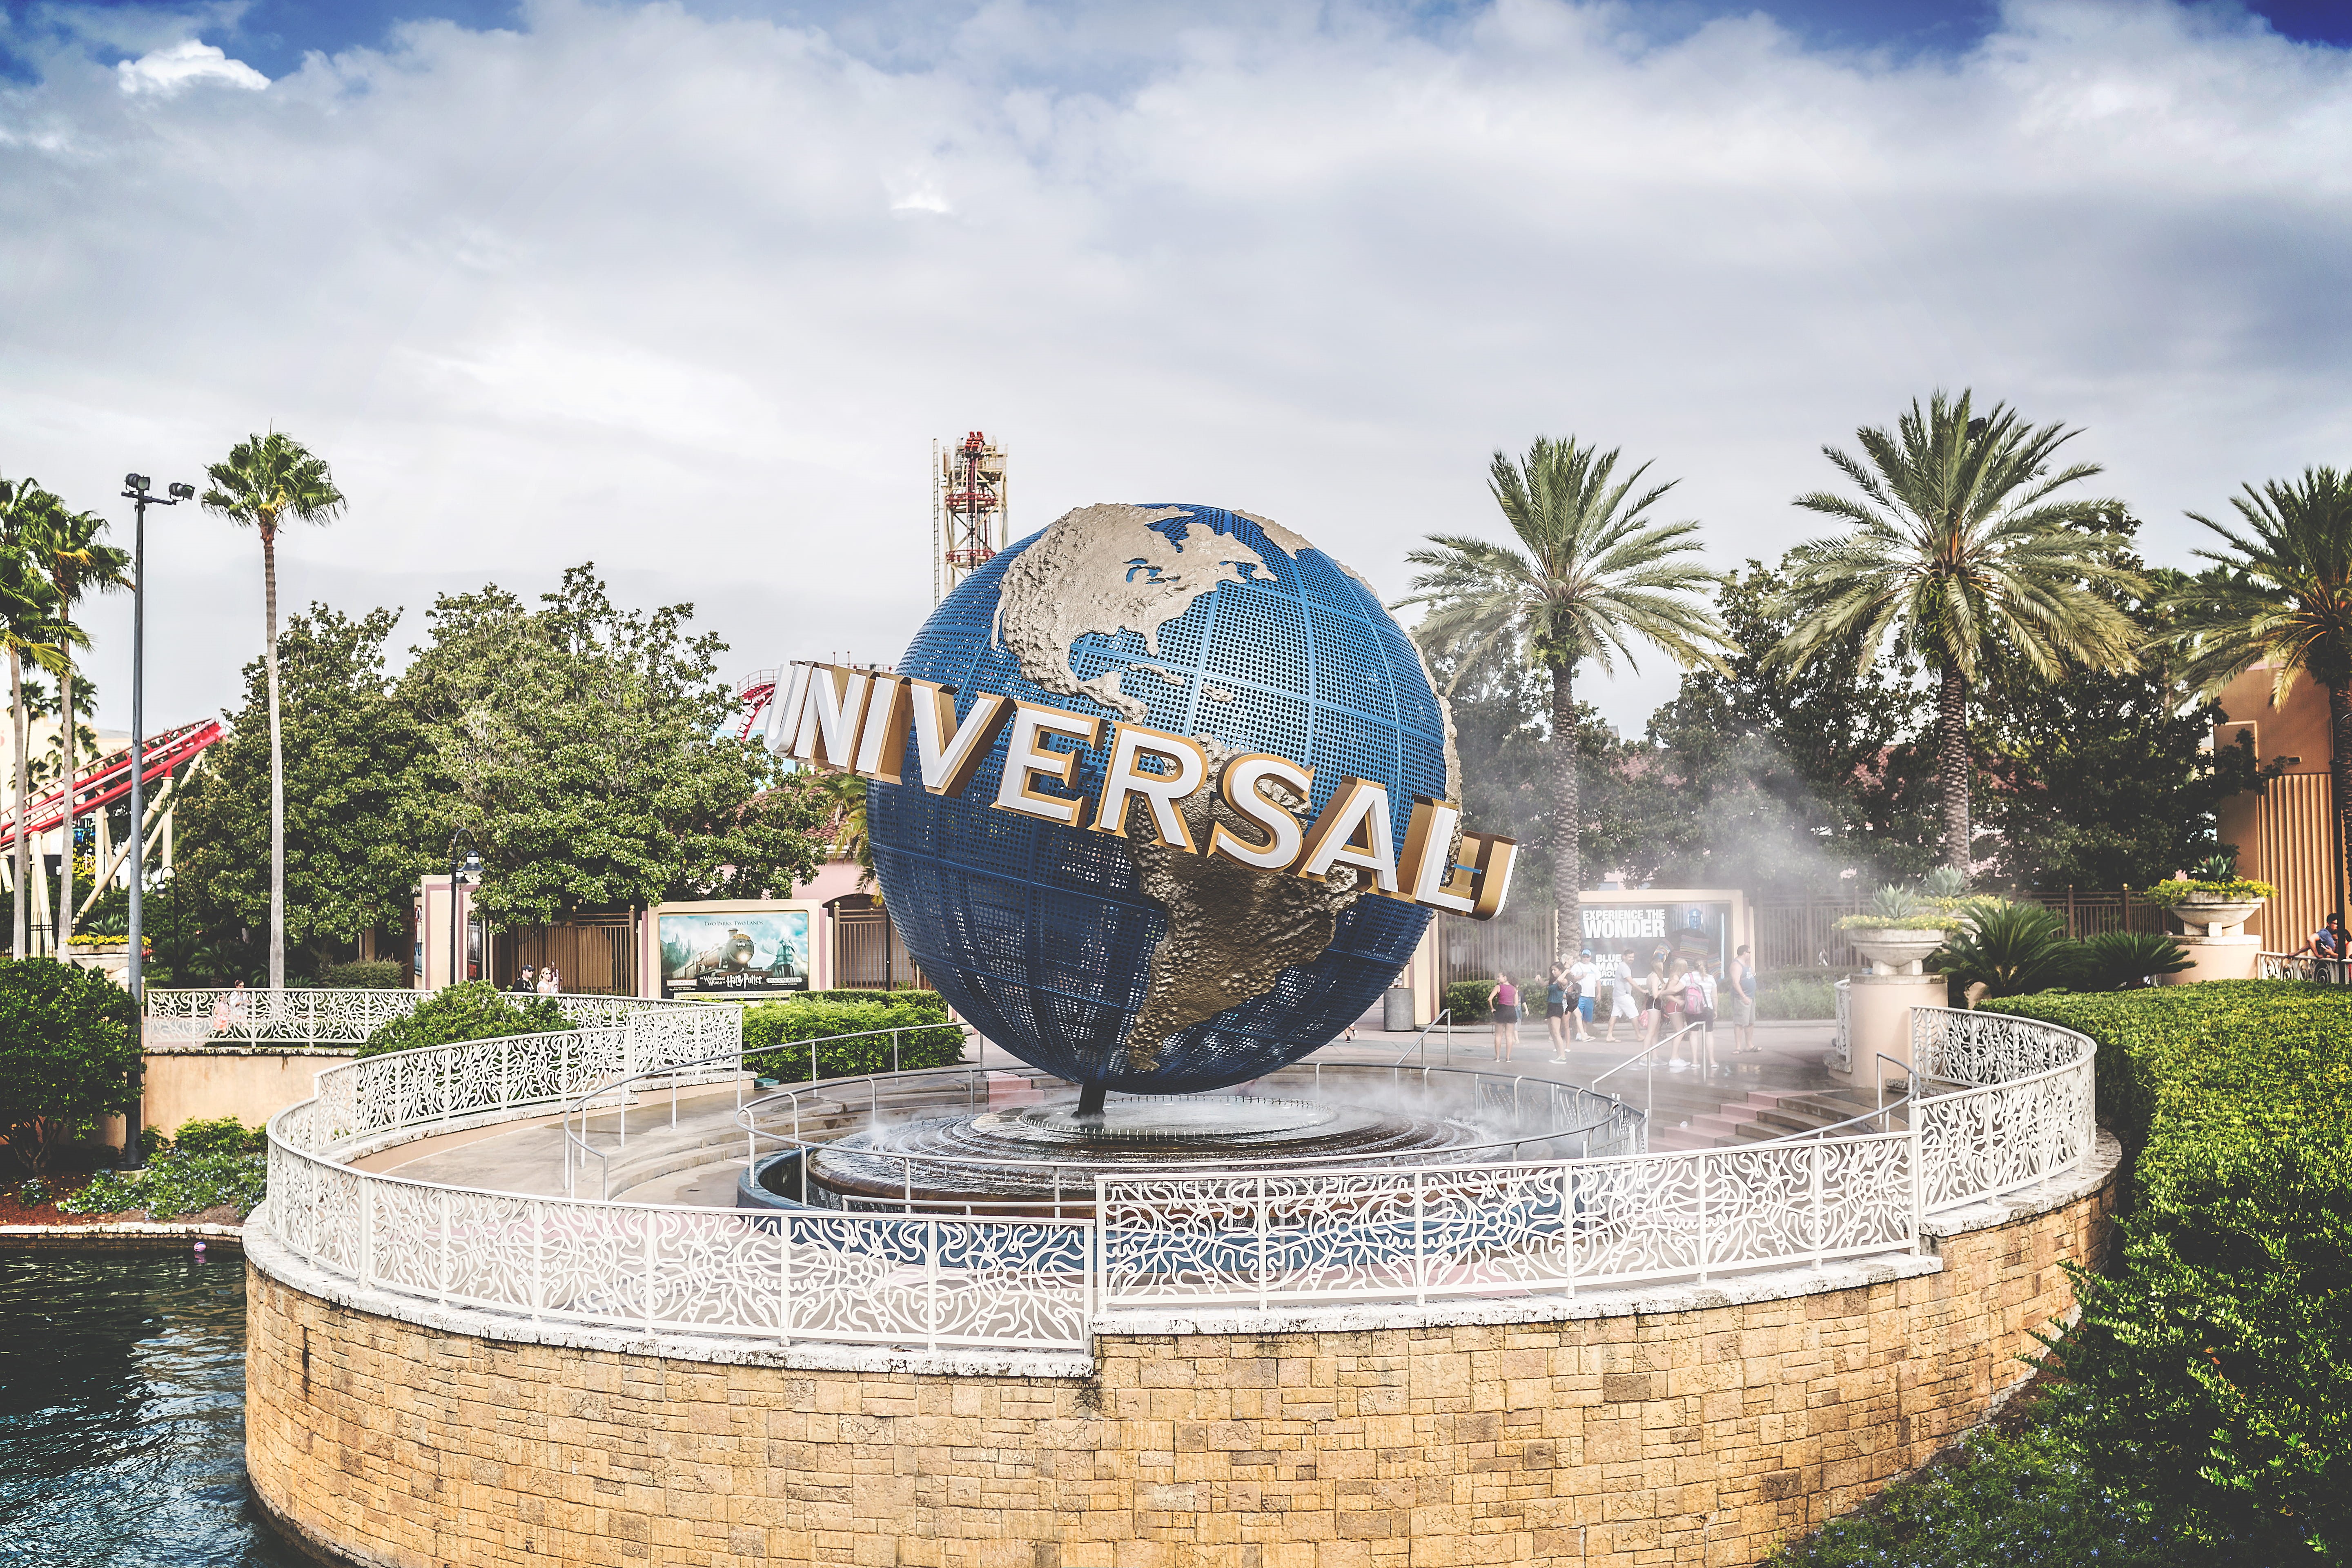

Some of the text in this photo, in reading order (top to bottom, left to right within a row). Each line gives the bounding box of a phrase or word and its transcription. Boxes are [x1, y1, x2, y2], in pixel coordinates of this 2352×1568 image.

[763, 660, 1477, 916] UNIVERSAL
[1583, 909, 1666, 920] EXPERIENCE THE
[1583, 919, 1666, 938] WONDER
[1596, 954, 1622, 962] BLUE
[726, 973, 762, 990] Harry Potter
